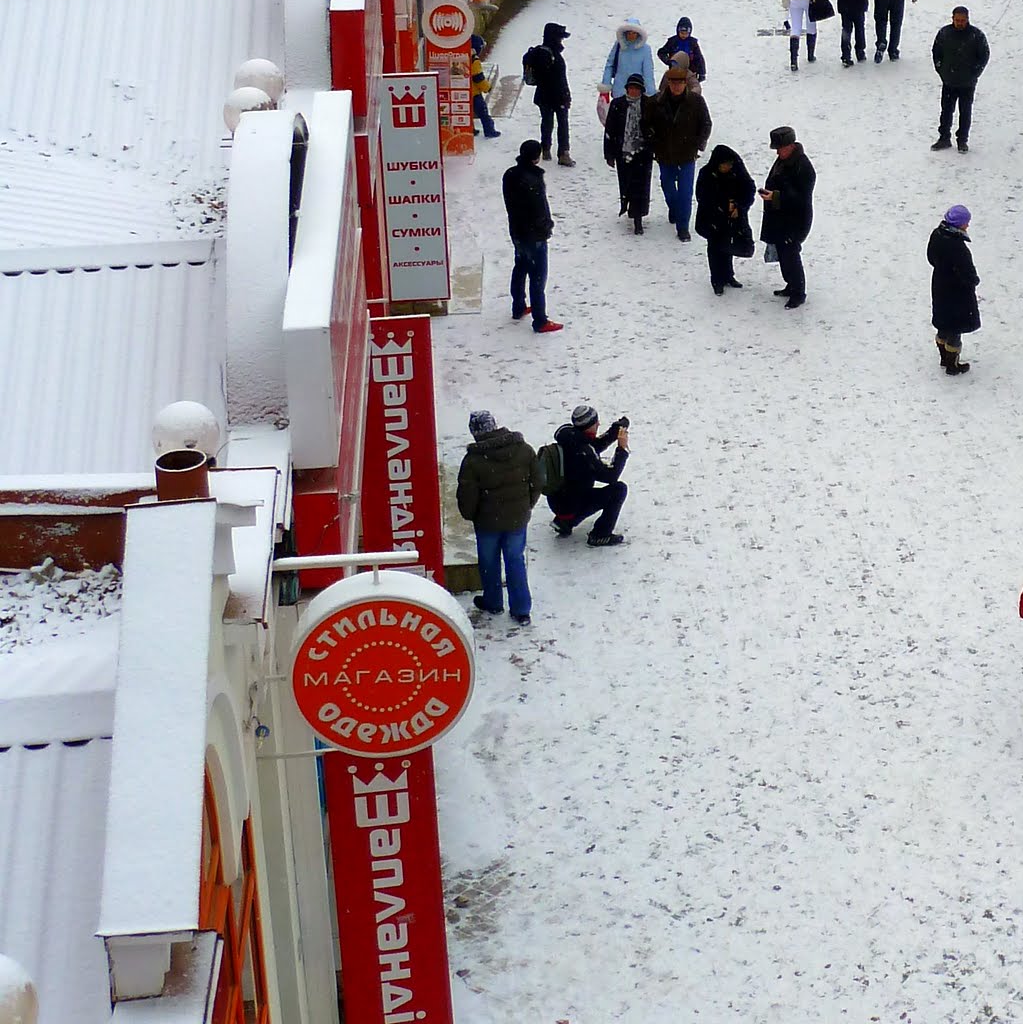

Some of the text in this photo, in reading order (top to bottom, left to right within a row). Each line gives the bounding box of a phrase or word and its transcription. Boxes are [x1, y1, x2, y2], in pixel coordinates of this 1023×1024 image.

[386, 160, 439, 172] ШУБКИ
[388, 193, 441, 206] ШАПКИ
[392, 227, 442, 238] СУМКИ
[392, 259, 444, 268] АКСЕССУАРЫ
[304, 668, 461, 687] МАГАЗИН
